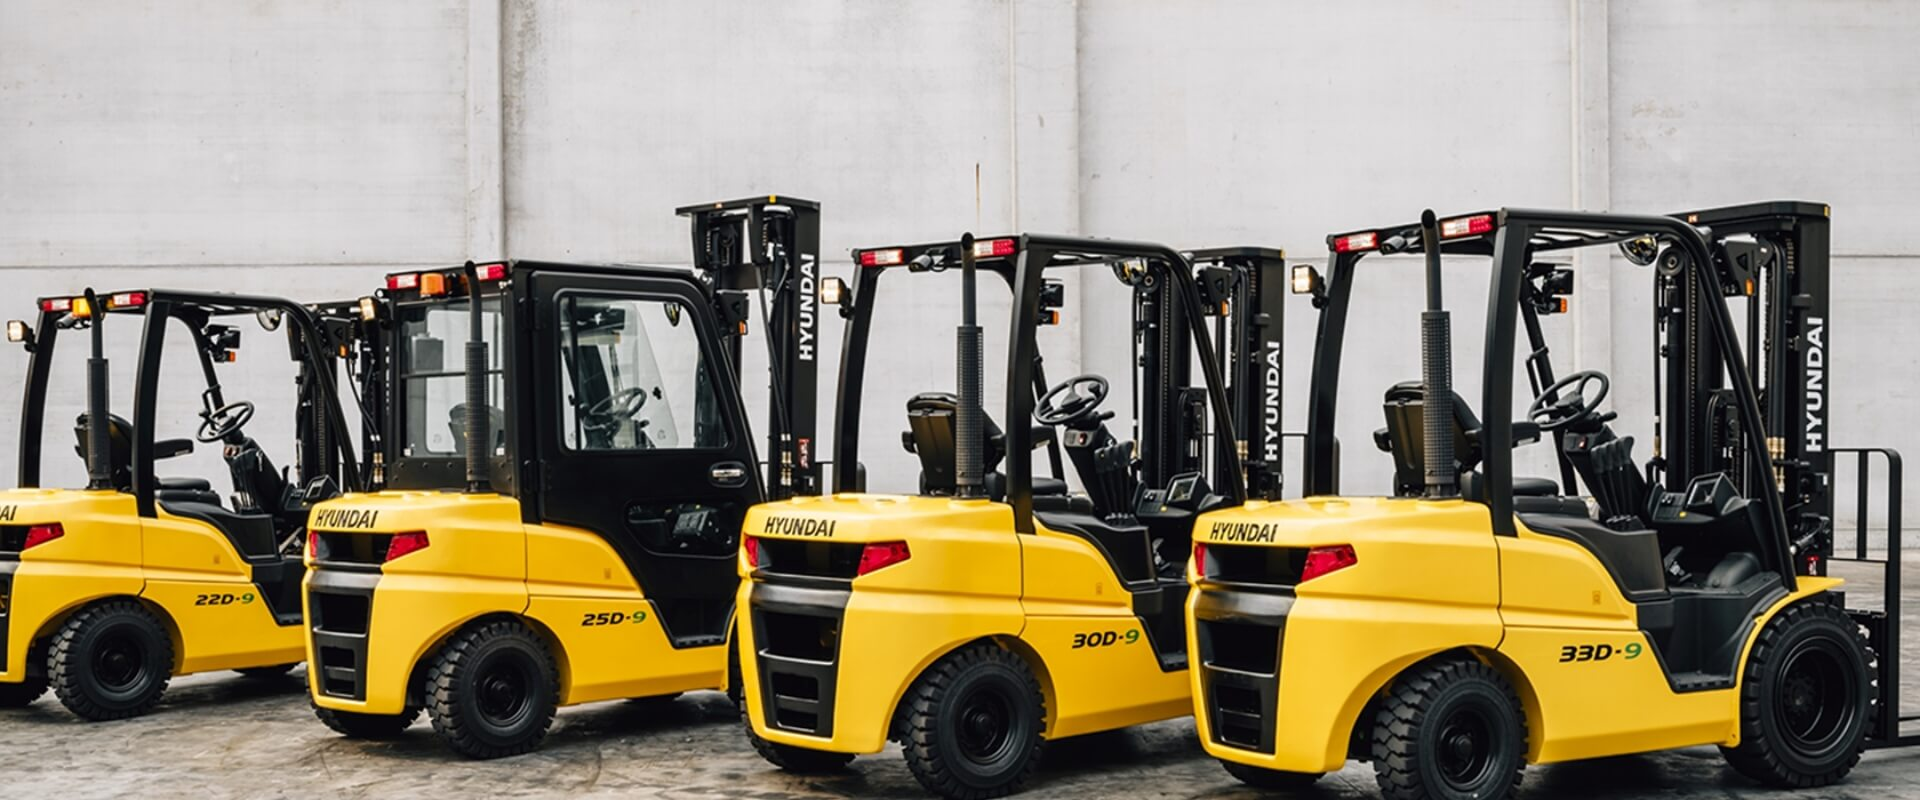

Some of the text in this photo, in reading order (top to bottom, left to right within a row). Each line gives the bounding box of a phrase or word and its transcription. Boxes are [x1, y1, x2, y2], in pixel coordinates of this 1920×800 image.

[799, 254, 815, 360] HYUNDAI
[1806, 317, 1823, 452] HYUNDAI
[1264, 341, 1280, 461] HYUNDAI
[314, 509, 379, 529] HYUNDAI
[764, 516, 837, 537] HYUNDAI
[1210, 522, 1279, 543] HYUNDAI
[195, 592, 255, 606] 22D-9
[581, 611, 647, 627] 25D-9
[1558, 642, 1643, 663] 33D-9
